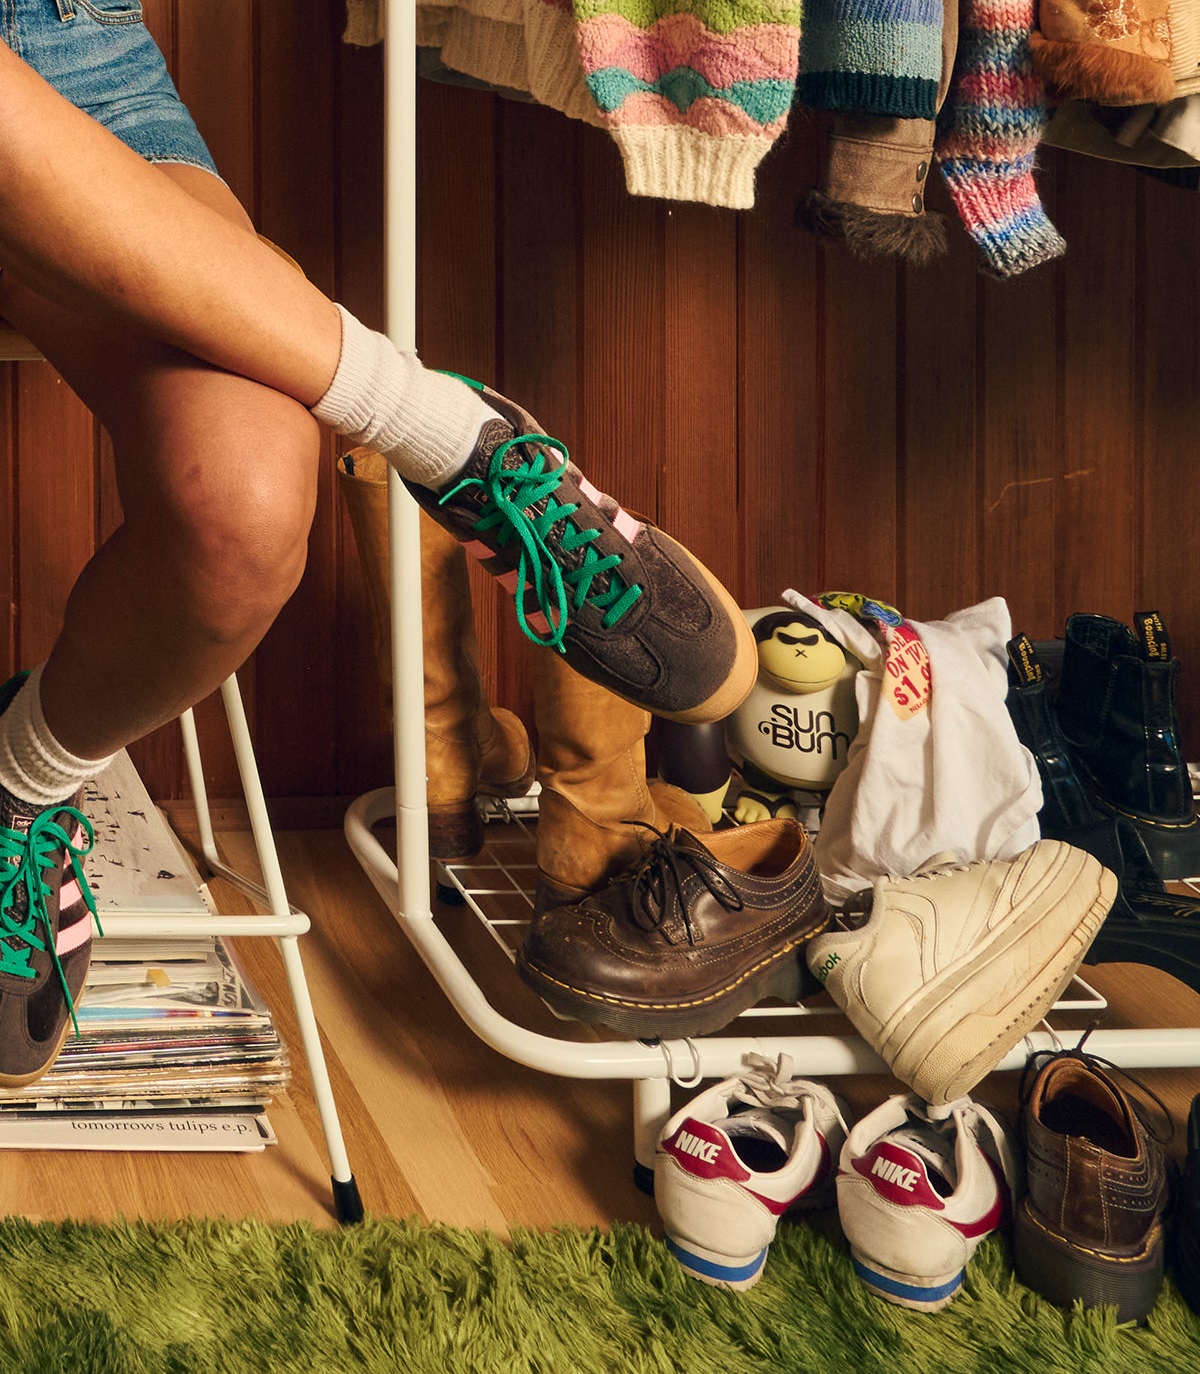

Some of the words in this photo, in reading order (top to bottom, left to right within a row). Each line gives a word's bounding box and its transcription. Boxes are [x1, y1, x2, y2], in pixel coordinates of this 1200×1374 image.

[886, 654, 910, 679] ON
[71, 1121, 165, 1131] tomorrows
[169, 1120, 218, 1134] tulips
[221, 1123, 253, 1135] e.p.
[674, 1130, 723, 1165] NIKE
[871, 1157, 922, 1193] NIKE
